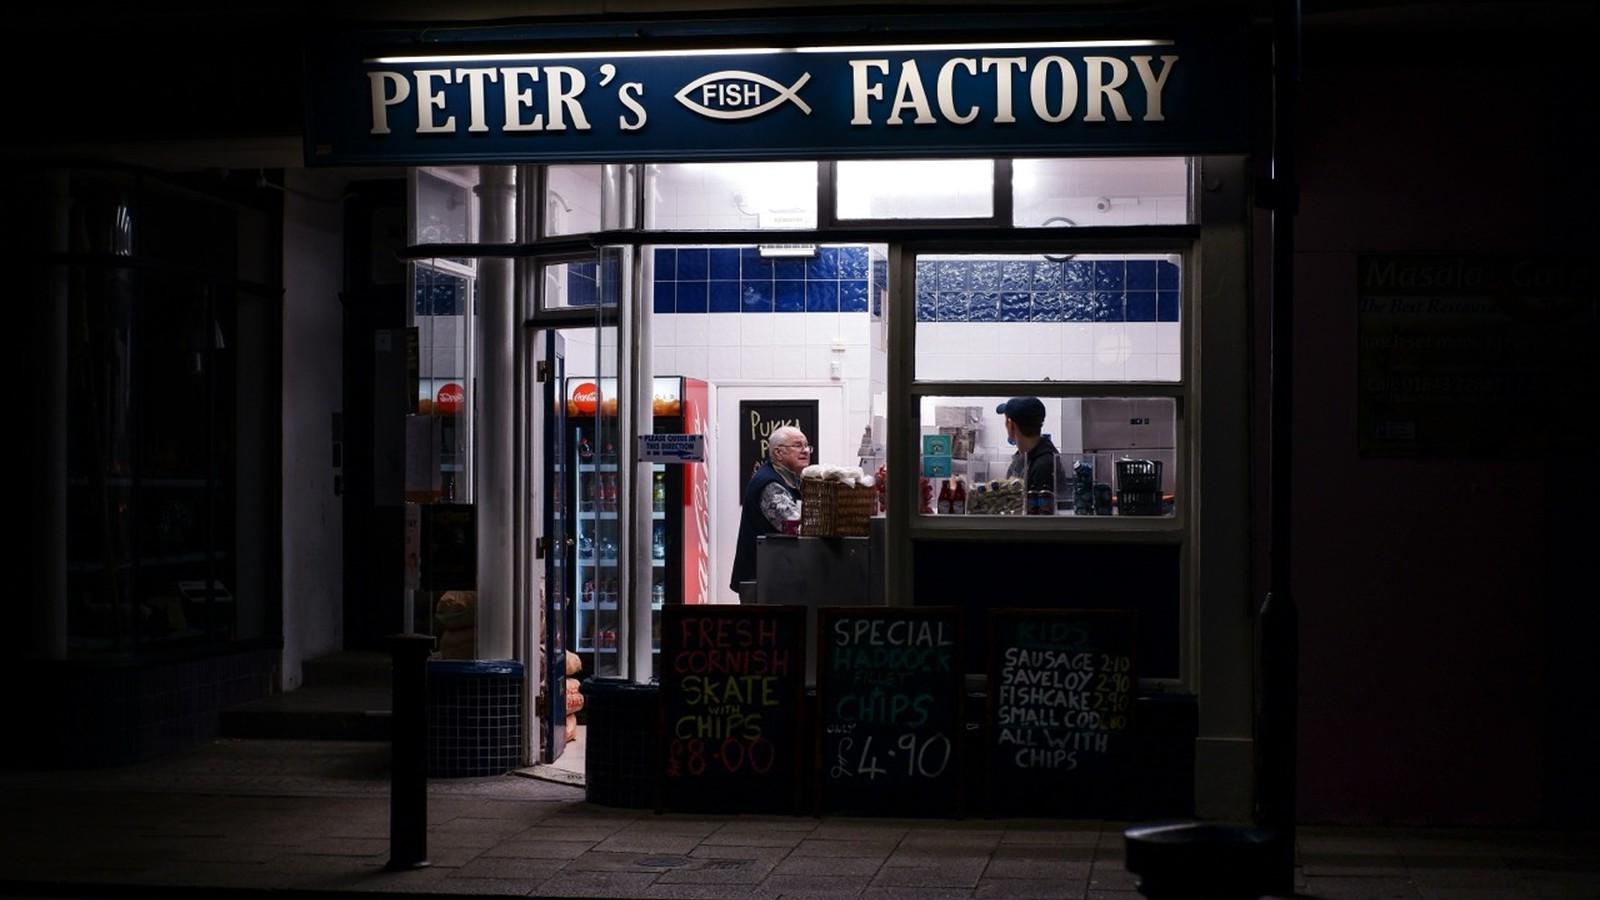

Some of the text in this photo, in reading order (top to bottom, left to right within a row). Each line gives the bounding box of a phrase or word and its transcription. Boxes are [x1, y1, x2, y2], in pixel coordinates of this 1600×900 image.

[366, 55, 1179, 134] PETER's FISH FACTORY
[1364, 259, 1483, 289] Masala
[646, 442, 694, 450] THIS DIRECTION
[681, 617, 778, 649] FRESH
[833, 618, 955, 648] SPECIAL
[1018, 621, 1088, 645] KIDS
[673, 649, 789, 677] CORNISH
[832, 645, 952, 673] HADDOCK
[1003, 647, 1096, 671] SAUSAGE
[680, 675, 781, 706] SKATE
[1001, 666, 1095, 692] SAVELOY
[707, 703, 741, 715] WITH
[836, 692, 936, 728] CHIPS
[999, 685, 1092, 712] FISHCAKE
[675, 713, 764, 741] CHIPS
[997, 704, 1061, 727] SMALL
[1063, 709, 1100, 731] COD
[997, 727, 1110, 754] ALL WITH
[1014, 747, 1079, 772] CHIPS
